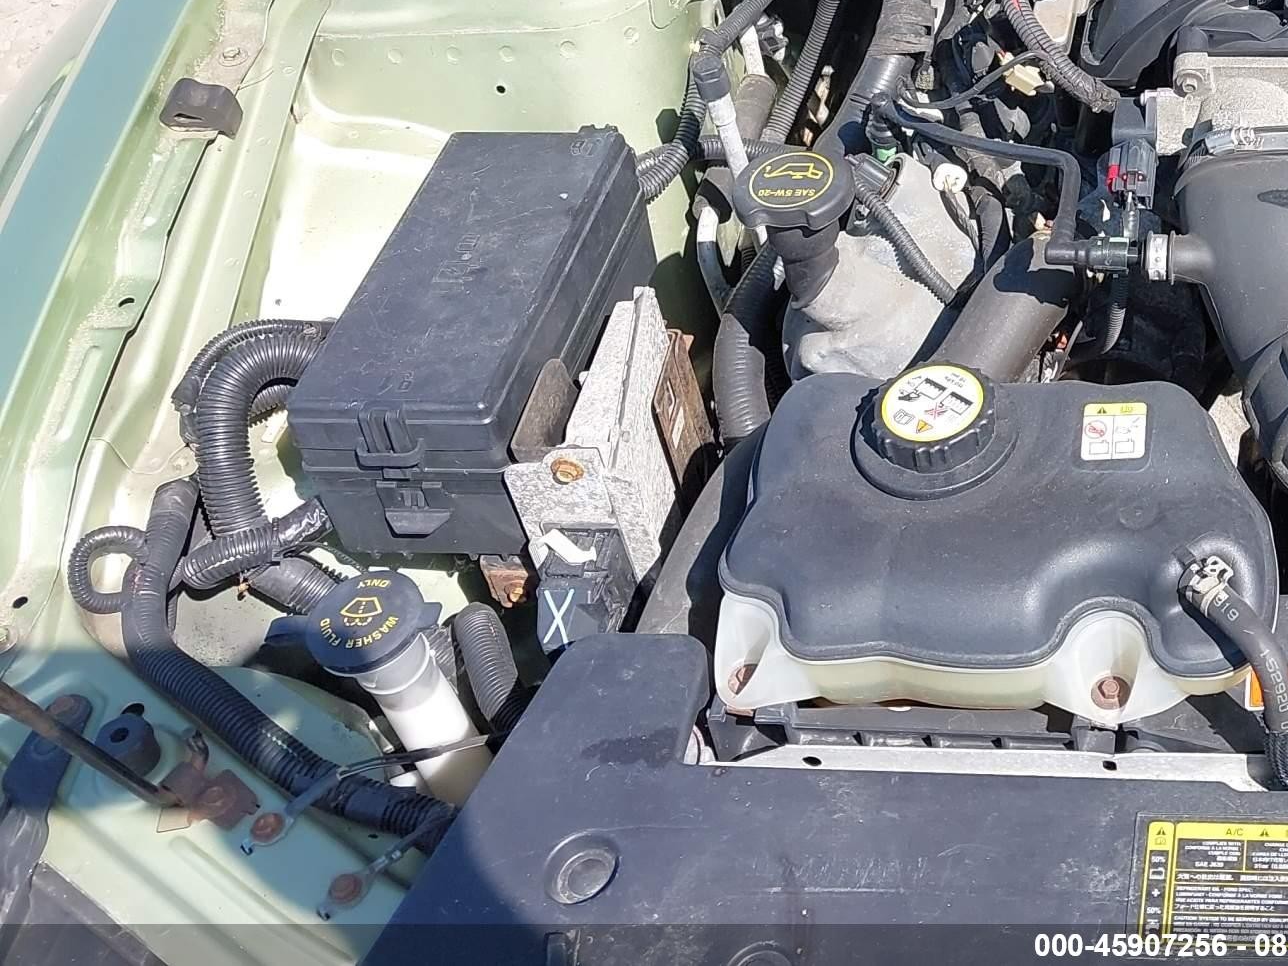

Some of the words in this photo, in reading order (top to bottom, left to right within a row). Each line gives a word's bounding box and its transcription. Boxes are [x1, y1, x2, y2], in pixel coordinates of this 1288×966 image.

[758, 188, 794, 198] 5W-20
[795, 188, 816, 197] SAE
[356, 579, 392, 589] ONLY
[319, 617, 342, 647] FLUID
[345, 616, 399, 649] WASHER
[1225, 827, 1244, 836] A/C
